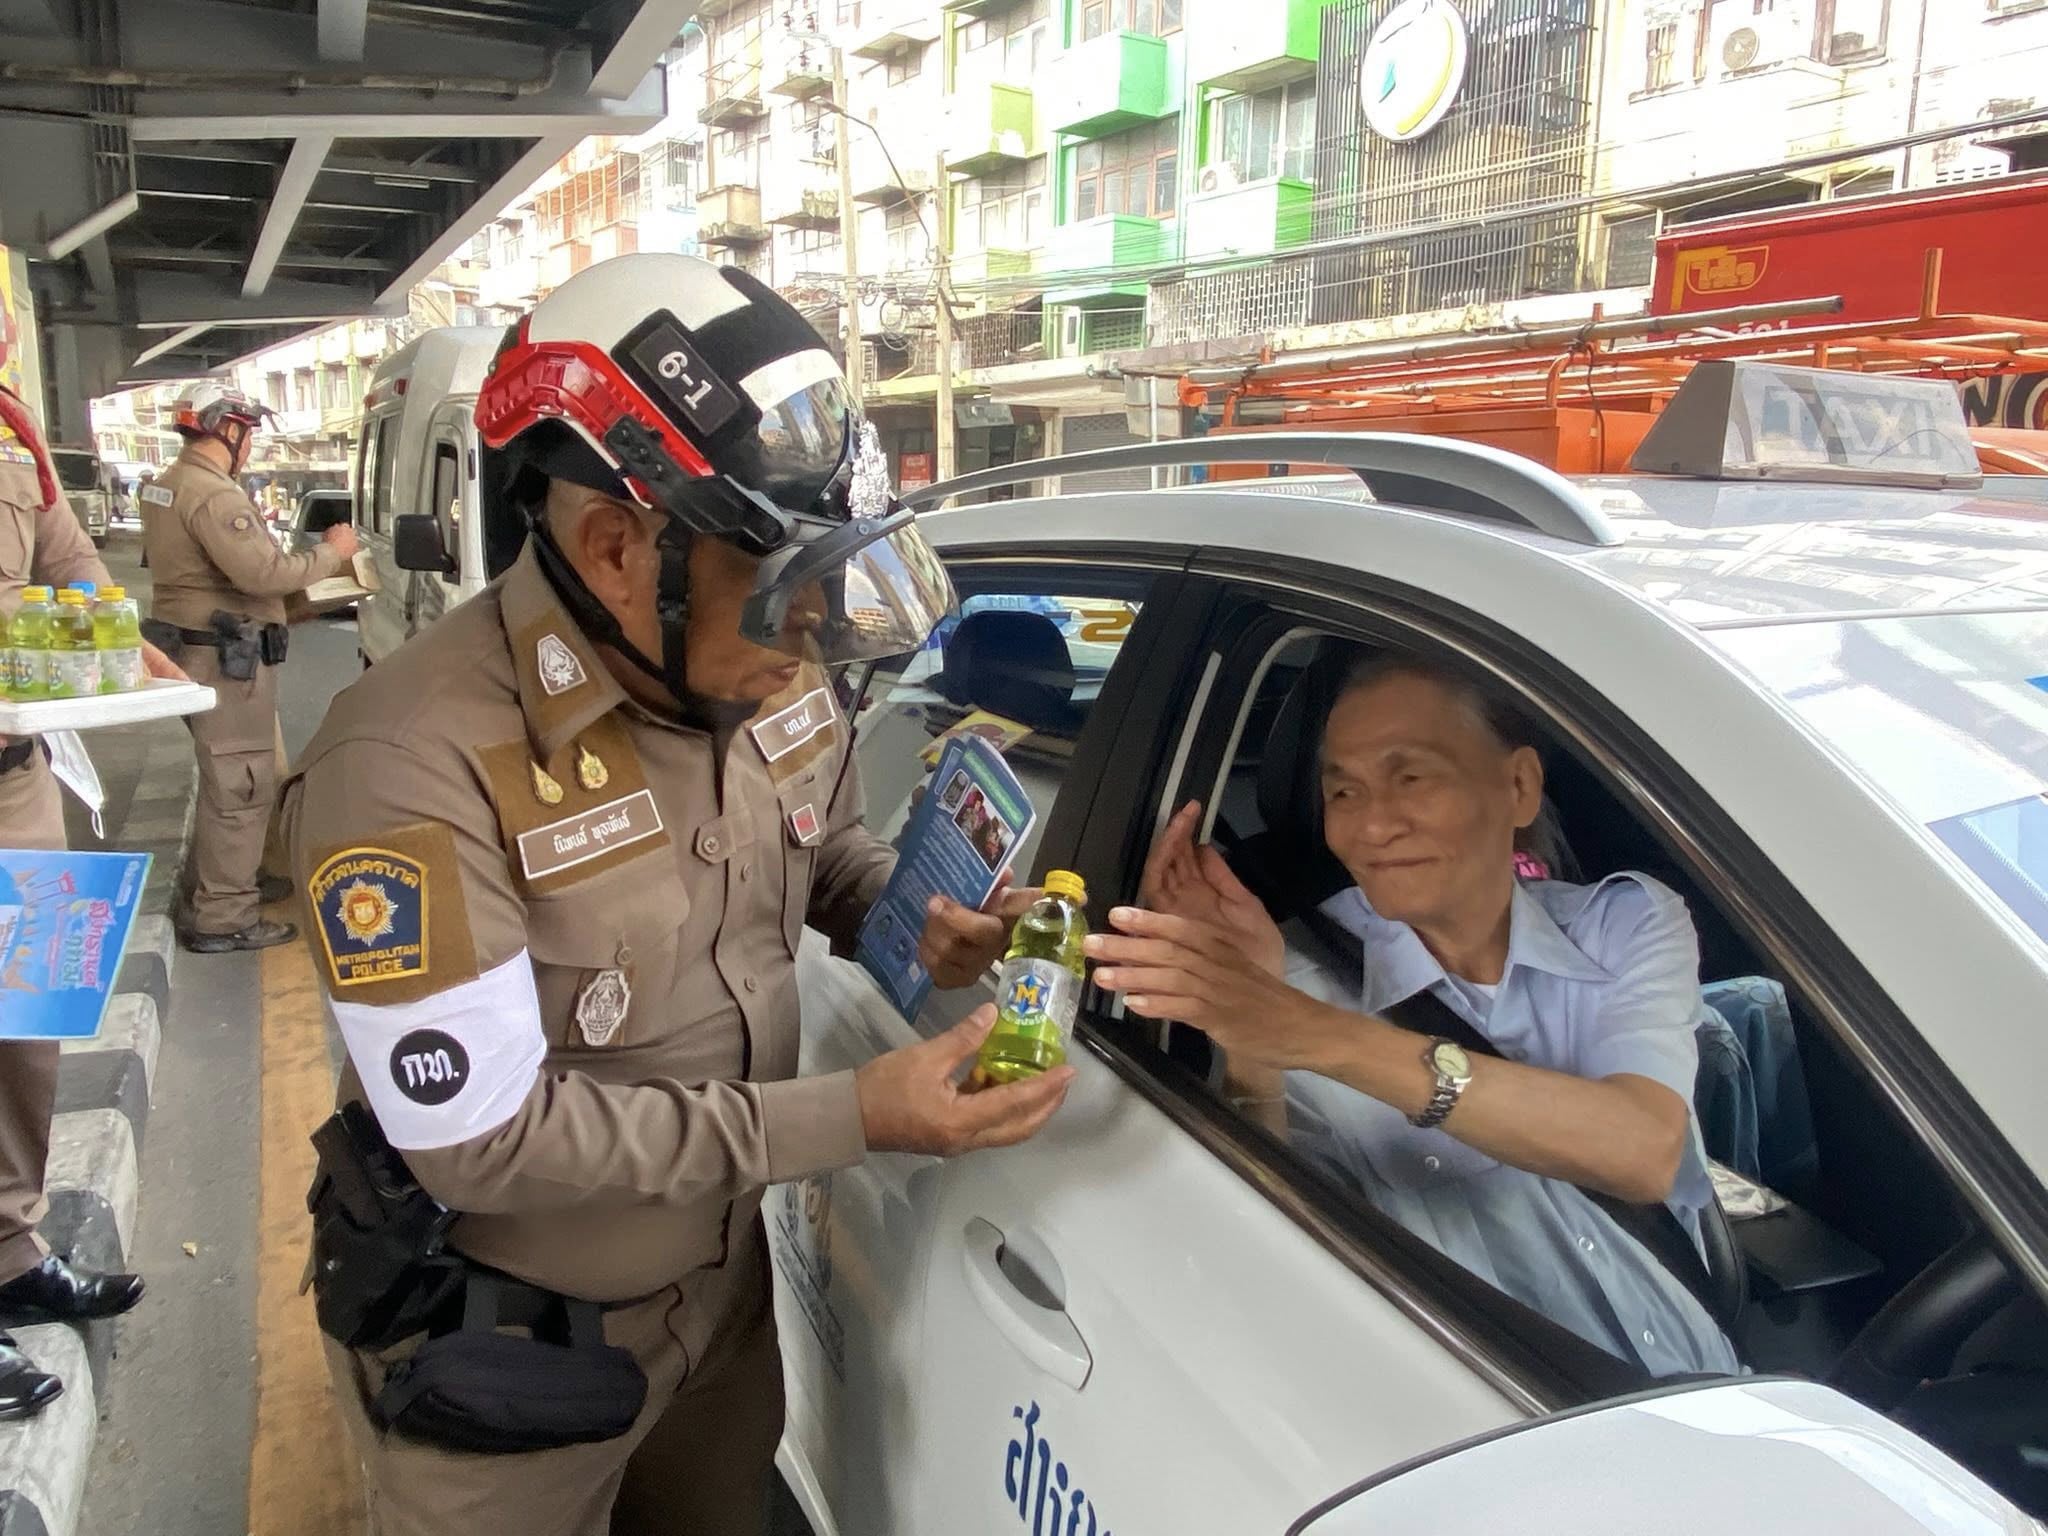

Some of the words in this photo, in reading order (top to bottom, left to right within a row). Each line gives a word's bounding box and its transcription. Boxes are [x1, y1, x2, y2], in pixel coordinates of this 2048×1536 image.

[658, 351, 712, 410] 6-1
[1764, 385, 1938, 458] TAXI
[335, 943, 420, 965] METROPOLITAN
[351, 958, 404, 978] POLICE
[1015, 983, 1039, 1008] M
